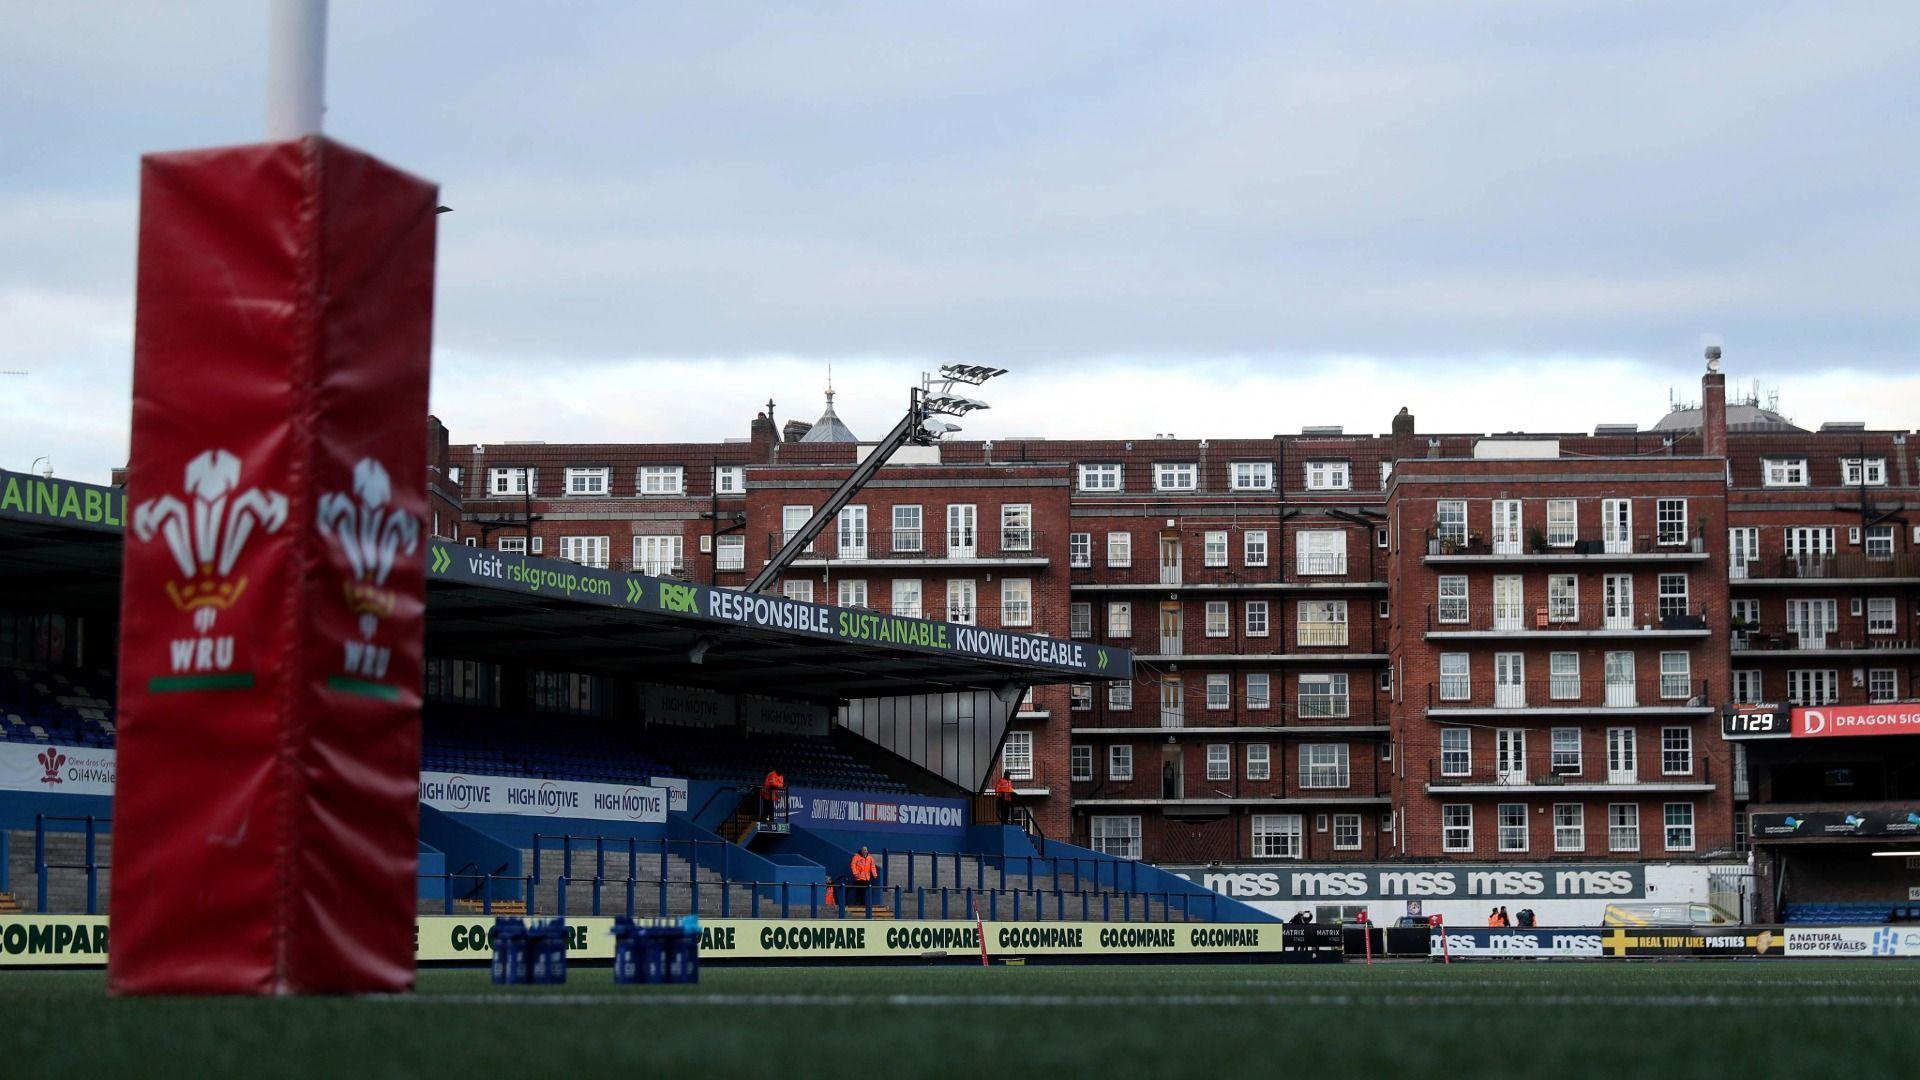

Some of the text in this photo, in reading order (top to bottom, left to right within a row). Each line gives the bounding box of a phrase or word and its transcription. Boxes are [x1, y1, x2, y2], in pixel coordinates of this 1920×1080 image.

[469, 553, 611, 596] visit rskgroup.com
[659, 582, 1087, 668] RSK RESPONSIBLE. SUSTAINABLE. KNOWLEDGEABLE.
[170, 636, 234, 672] WRU
[344, 640, 391, 680] WRU
[1837, 714, 1896, 727] DRAGON
[1899, 713, 1920, 724] SIG
[446, 784, 491, 803] MOTIVE
[507, 787, 579, 808] HIGH MOTIVE
[594, 793, 660, 813] HIGH MOTIVE
[811, 799, 829, 819] SOUTH
[865, 803, 876, 820] HIT
[876, 804, 897, 822] MUSIC
[899, 805, 962, 826] STATION
[1292, 872, 1368, 896] mss
[1380, 872, 1456, 896] mss
[1468, 871, 1545, 895] mss
[1556, 871, 1633, 895] mss
[0, 924, 110, 955] OMPAR
[760, 927, 865, 950] GO.COMPARE
[886, 927, 979, 949] GO.COMPARE
[1000, 927, 1083, 948] GO.COMPARE
[1100, 928, 1175, 948] GO.COMPARE
[1190, 928, 1259, 947] GO.COMPARE
[1489, 934, 1539, 950] mss
[1552, 934, 1602, 950] mss
[1640, 936, 1745, 948] REAL TIDY LIKE PASTIES
[1789, 942, 1867, 950] DROP OF WALES
